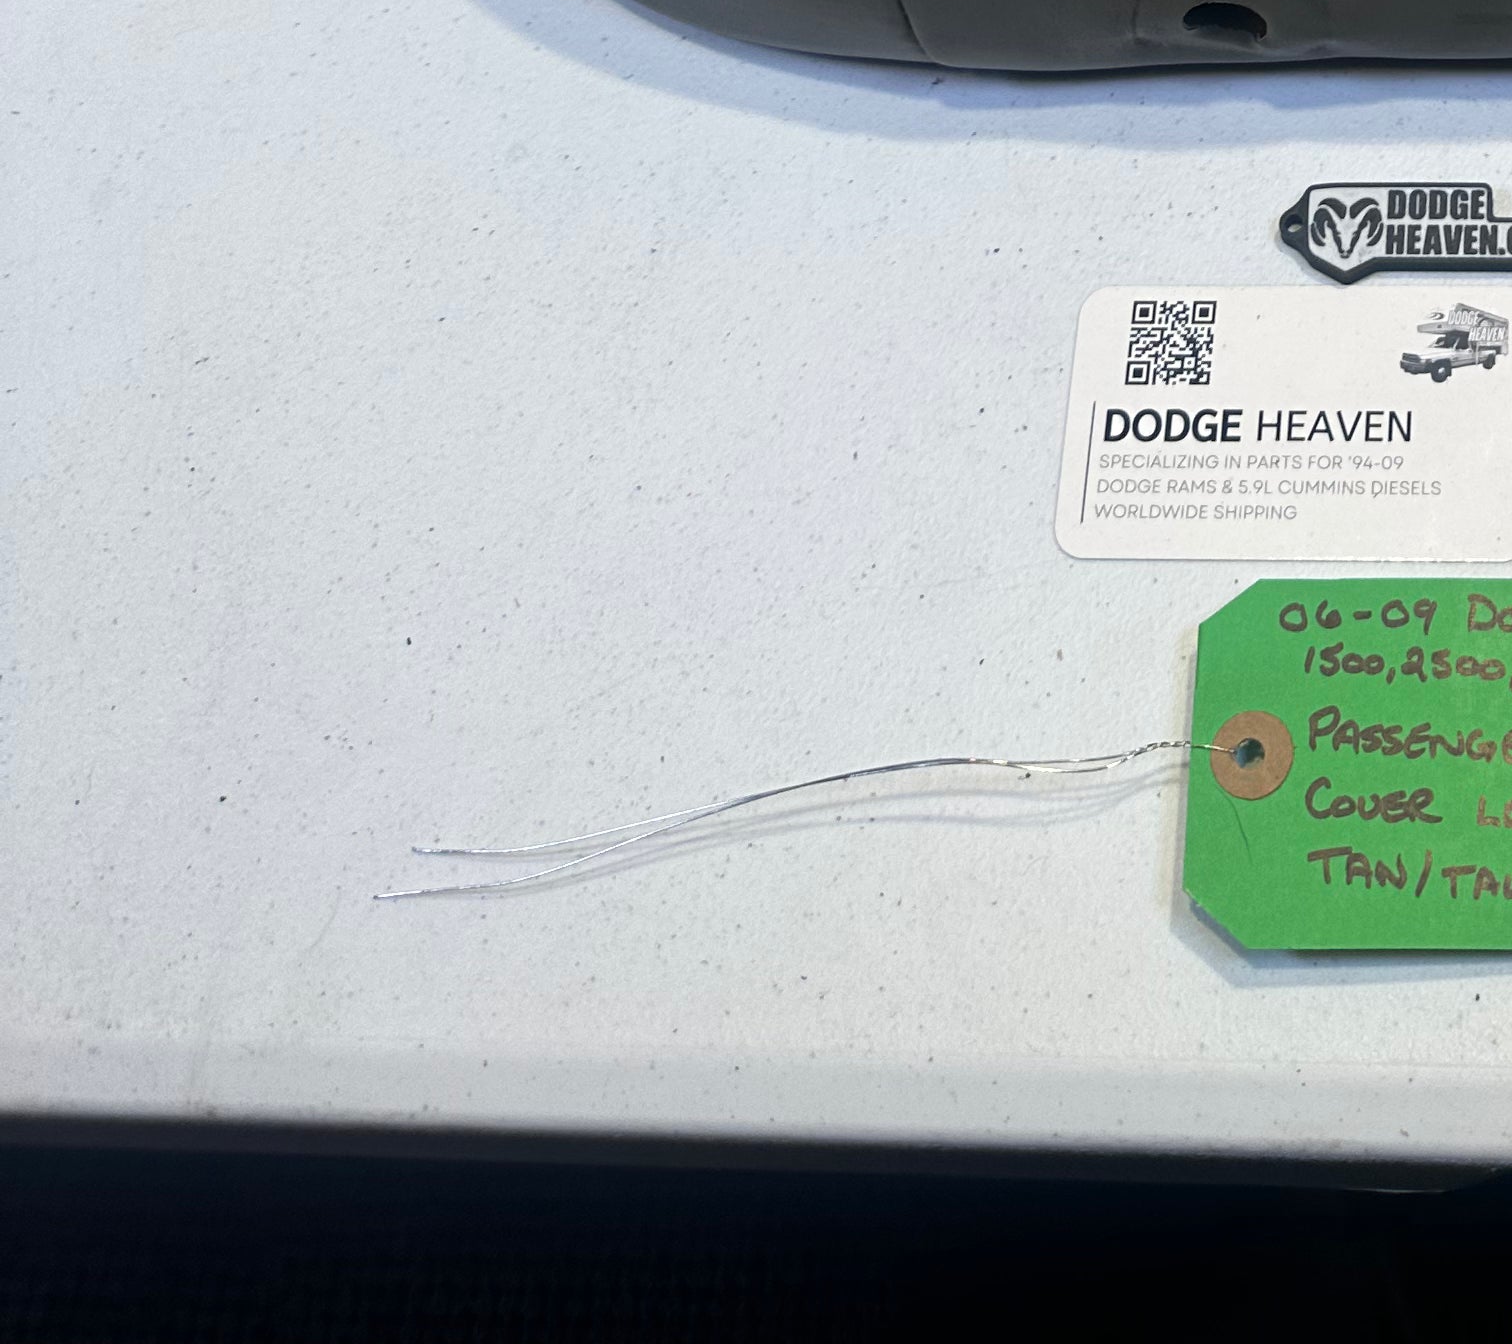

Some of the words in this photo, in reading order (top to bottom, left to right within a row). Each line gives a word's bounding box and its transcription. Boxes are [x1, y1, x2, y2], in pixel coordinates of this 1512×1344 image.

[1387, 189, 1486, 221] DODGE
[1447, 311, 1481, 325] DODGE
[1468, 327, 1506, 341] HEAVEN
[1103, 408, 1243, 442] DODGE
[1256, 410, 1412, 442] HEAVEN
[1099, 454, 1219, 469] SPECIALIZING
[1224, 455, 1241, 469] IN
[1247, 455, 1302, 470] PARTS
[1307, 455, 1342, 470] FOR
[1348, 455, 1403, 470] '94-09
[1097, 478, 1161, 494] DODGE
[1167, 479, 1216, 495] RAMS
[1221, 480, 1233, 495] &
[1239, 480, 1272, 495] 5.9L
[1277, 480, 1366, 496] CUMMINS
[1372, 480, 1441, 496] DIESELS
[1094, 504, 1207, 519] WORLDWIDE
[1214, 504, 1297, 520] SHIPPING
[1279, 599, 1438, 632] 06-09
[1305, 777, 1443, 824] COVER
